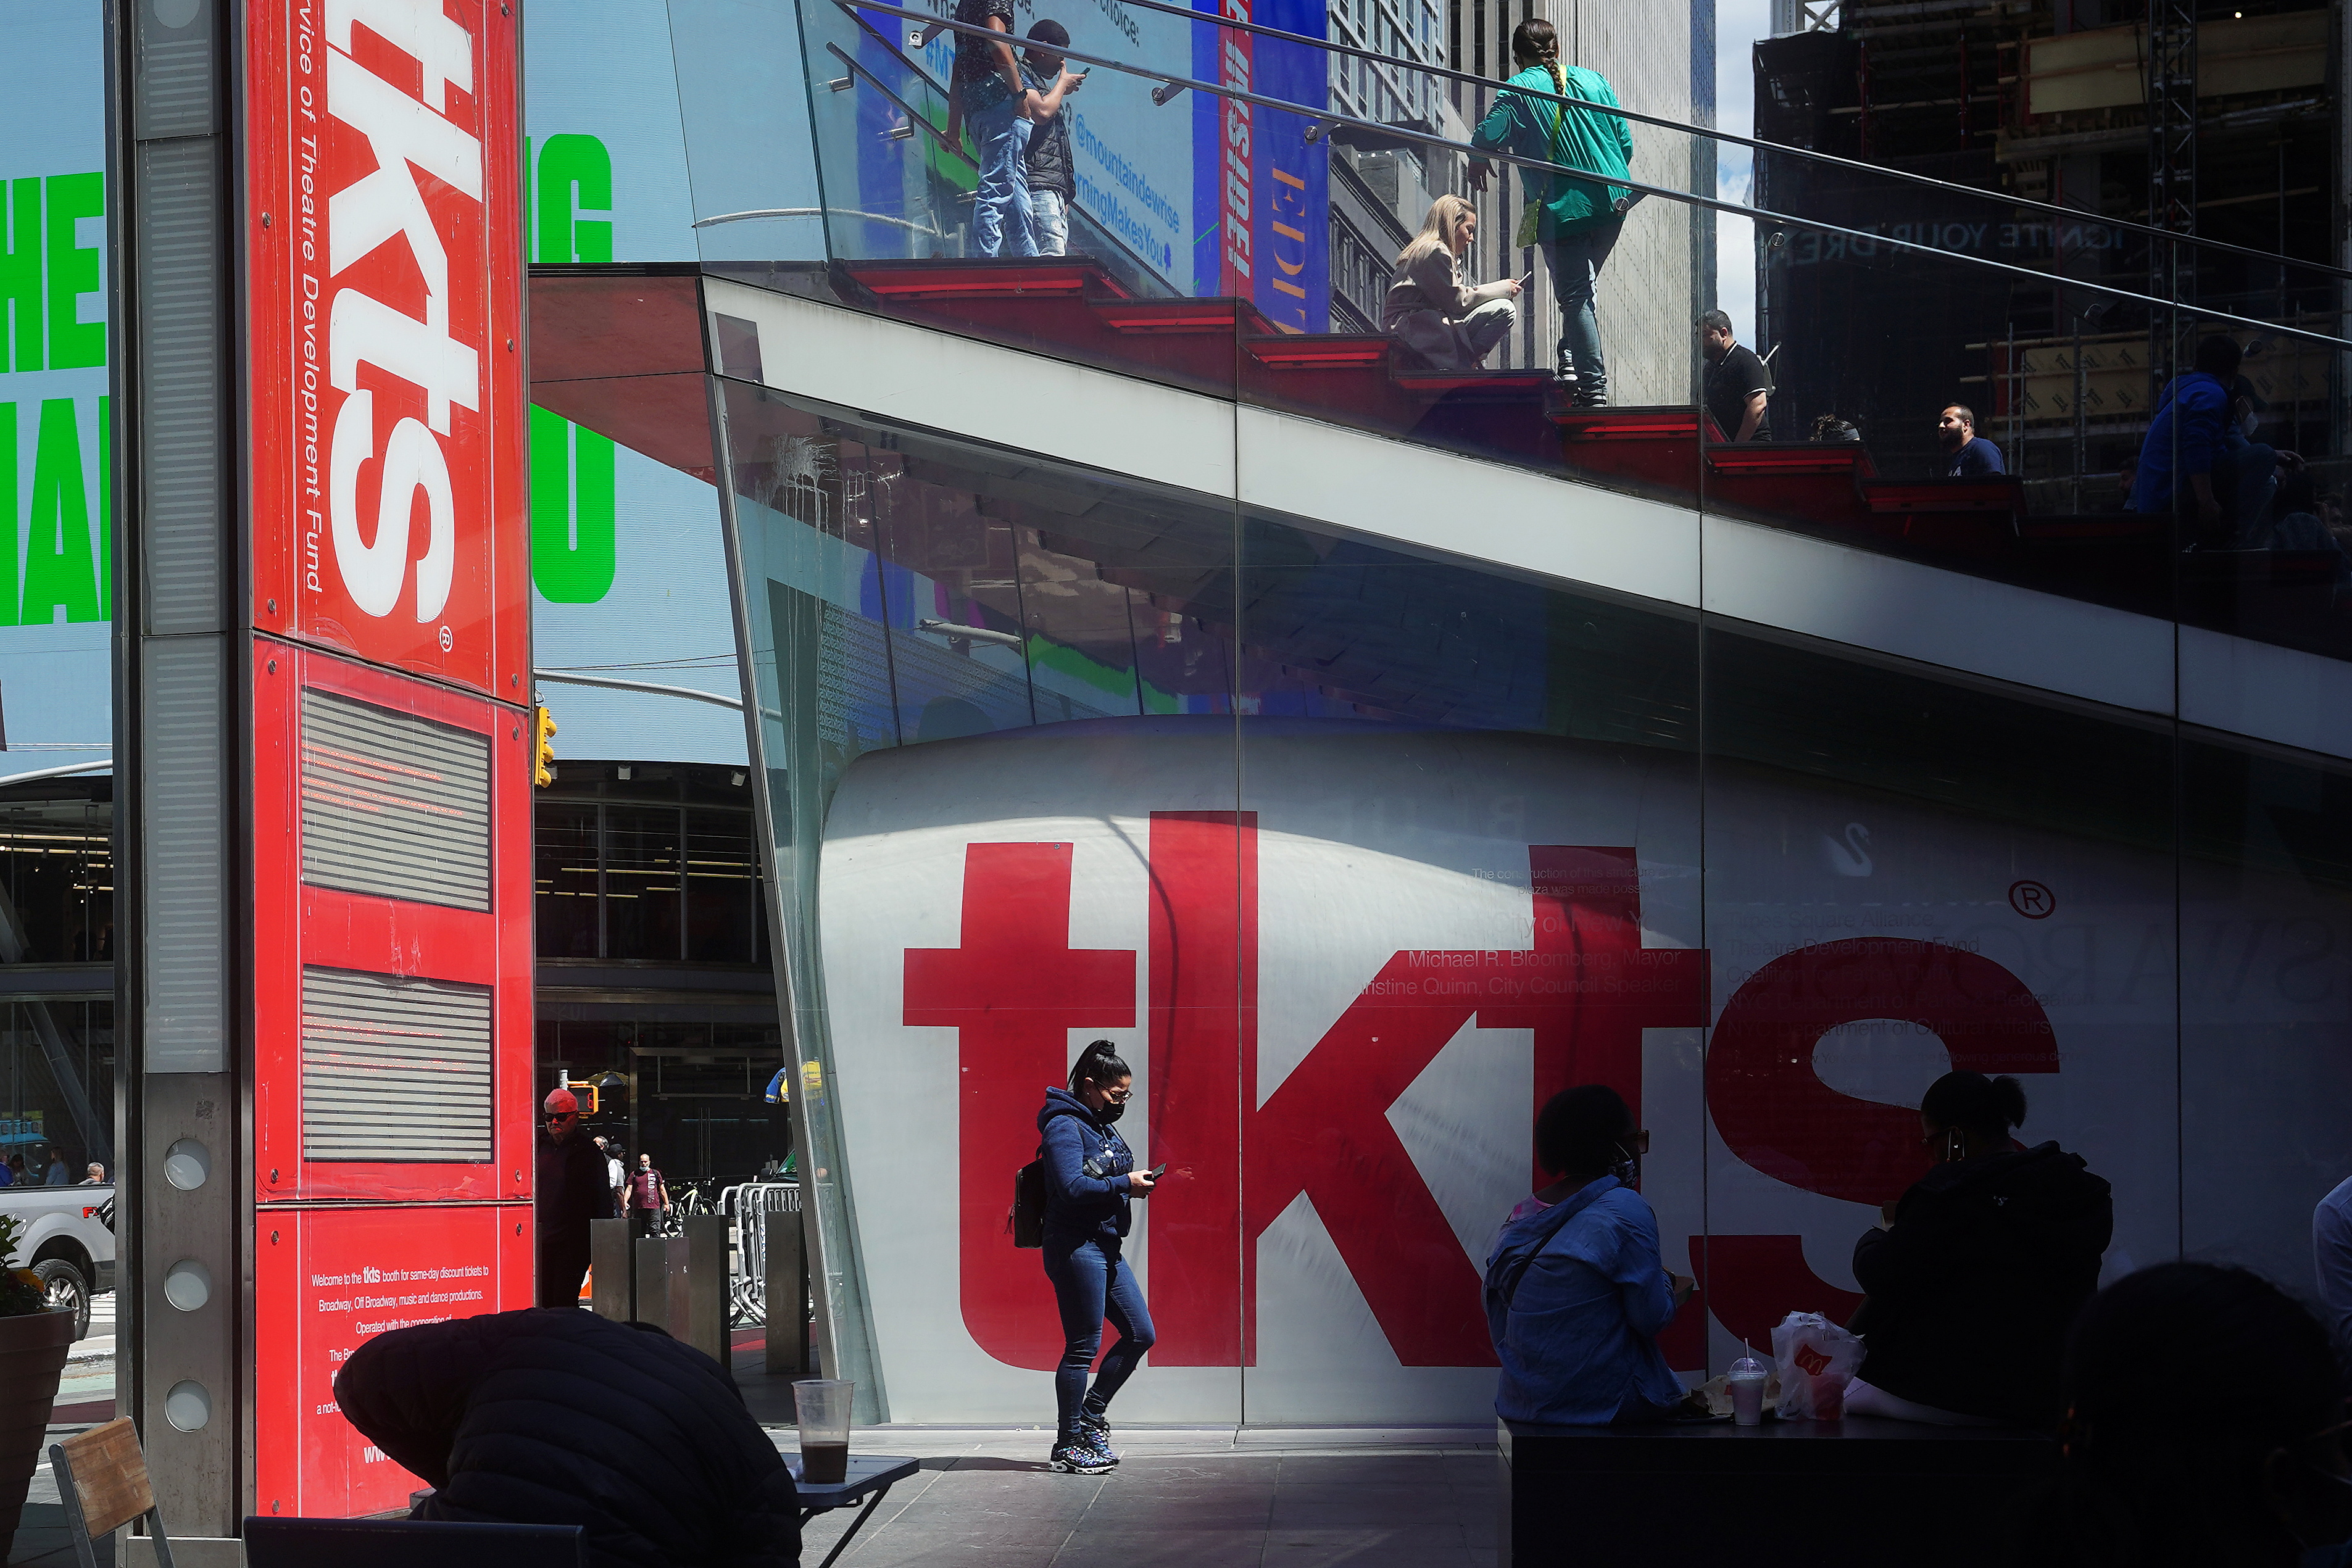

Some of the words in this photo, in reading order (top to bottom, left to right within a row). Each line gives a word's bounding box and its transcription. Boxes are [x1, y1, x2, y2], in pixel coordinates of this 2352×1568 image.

[300, 86, 315, 123] of
[1225, 38, 1250, 281] INSIDE!
[301, 134, 318, 262] Theatre
[1074, 172, 1163, 267] rningMakesYou
[302, 273, 319, 497] Development
[306, 508, 322, 593] Fund
[1497, 868, 1569, 879] consruction
[1571, 868, 1582, 879] of
[1583, 867, 1604, 878] this
[1606, 866, 1656, 878] structure
[1550, 886, 1576, 895] was
[1577, 884, 1610, 895] made
[1789, 911, 1855, 932] Square
[1861, 910, 1934, 927] Alliance
[1726, 939, 1797, 956] Theatre
[1803, 937, 1927, 960] Development
[1932, 935, 1980, 955] Fund
[1408, 949, 1479, 968] Michael
[1484, 949, 1505, 968] R.
[1510, 948, 1617, 971] Bloomberg,
[1622, 948, 1682, 971] Mayor
[1726, 964, 1805, 984] Coalition
[1423, 977, 1482, 997] Quinn,
[1488, 977, 1523, 998] City
[1529, 976, 1597, 995] Council
[1603, 976, 1683, 998] Speaker
[1727, 992, 1772, 1010] NYC
[1777, 990, 1887, 1014] Department
[1891, 990, 1909, 1008] of
[1914, 989, 1970, 1008] Parks
[1727, 1019, 1772, 1037] NYC
[1777, 1019, 1887, 1041] Department
[1892, 1018, 1911, 1035] of
[1915, 1016, 1987, 1035] Cultural
[1990, 1016, 2051, 1035] Affairs
[1939, 1050, 1989, 1064] following
[1991, 1051, 2047, 1065] generous
[903, 811, 2060, 1371] tkts
[312, 1274, 343, 1287] Welcome
[344, 1274, 351, 1285] to
[351, 1272, 362, 1284] the
[363, 1266, 381, 1284] tkts
[382, 1269, 400, 1282] booth
[401, 1269, 409, 1281] for
[410, 1267, 439, 1282] same-day
[440, 1266, 464, 1279] discount
[465, 1265, 483, 1277] tickets
[483, 1265, 489, 1276] to
[318, 1298, 353, 1313] Broadway,
[354, 1296, 364, 1309] Off
[365, 1295, 398, 1309] Broadway,
[399, 1293, 418, 1305] music
[418, 1292, 430, 1305] and
[430, 1292, 449, 1303] dance
[449, 1289, 484, 1305] productions.
[355, 1319, 385, 1337] Operated
[386, 1319, 399, 1332] with
[400, 1318, 410, 1329] the
[329, 1349, 343, 1362] The
[316, 1404, 322, 1415] a
